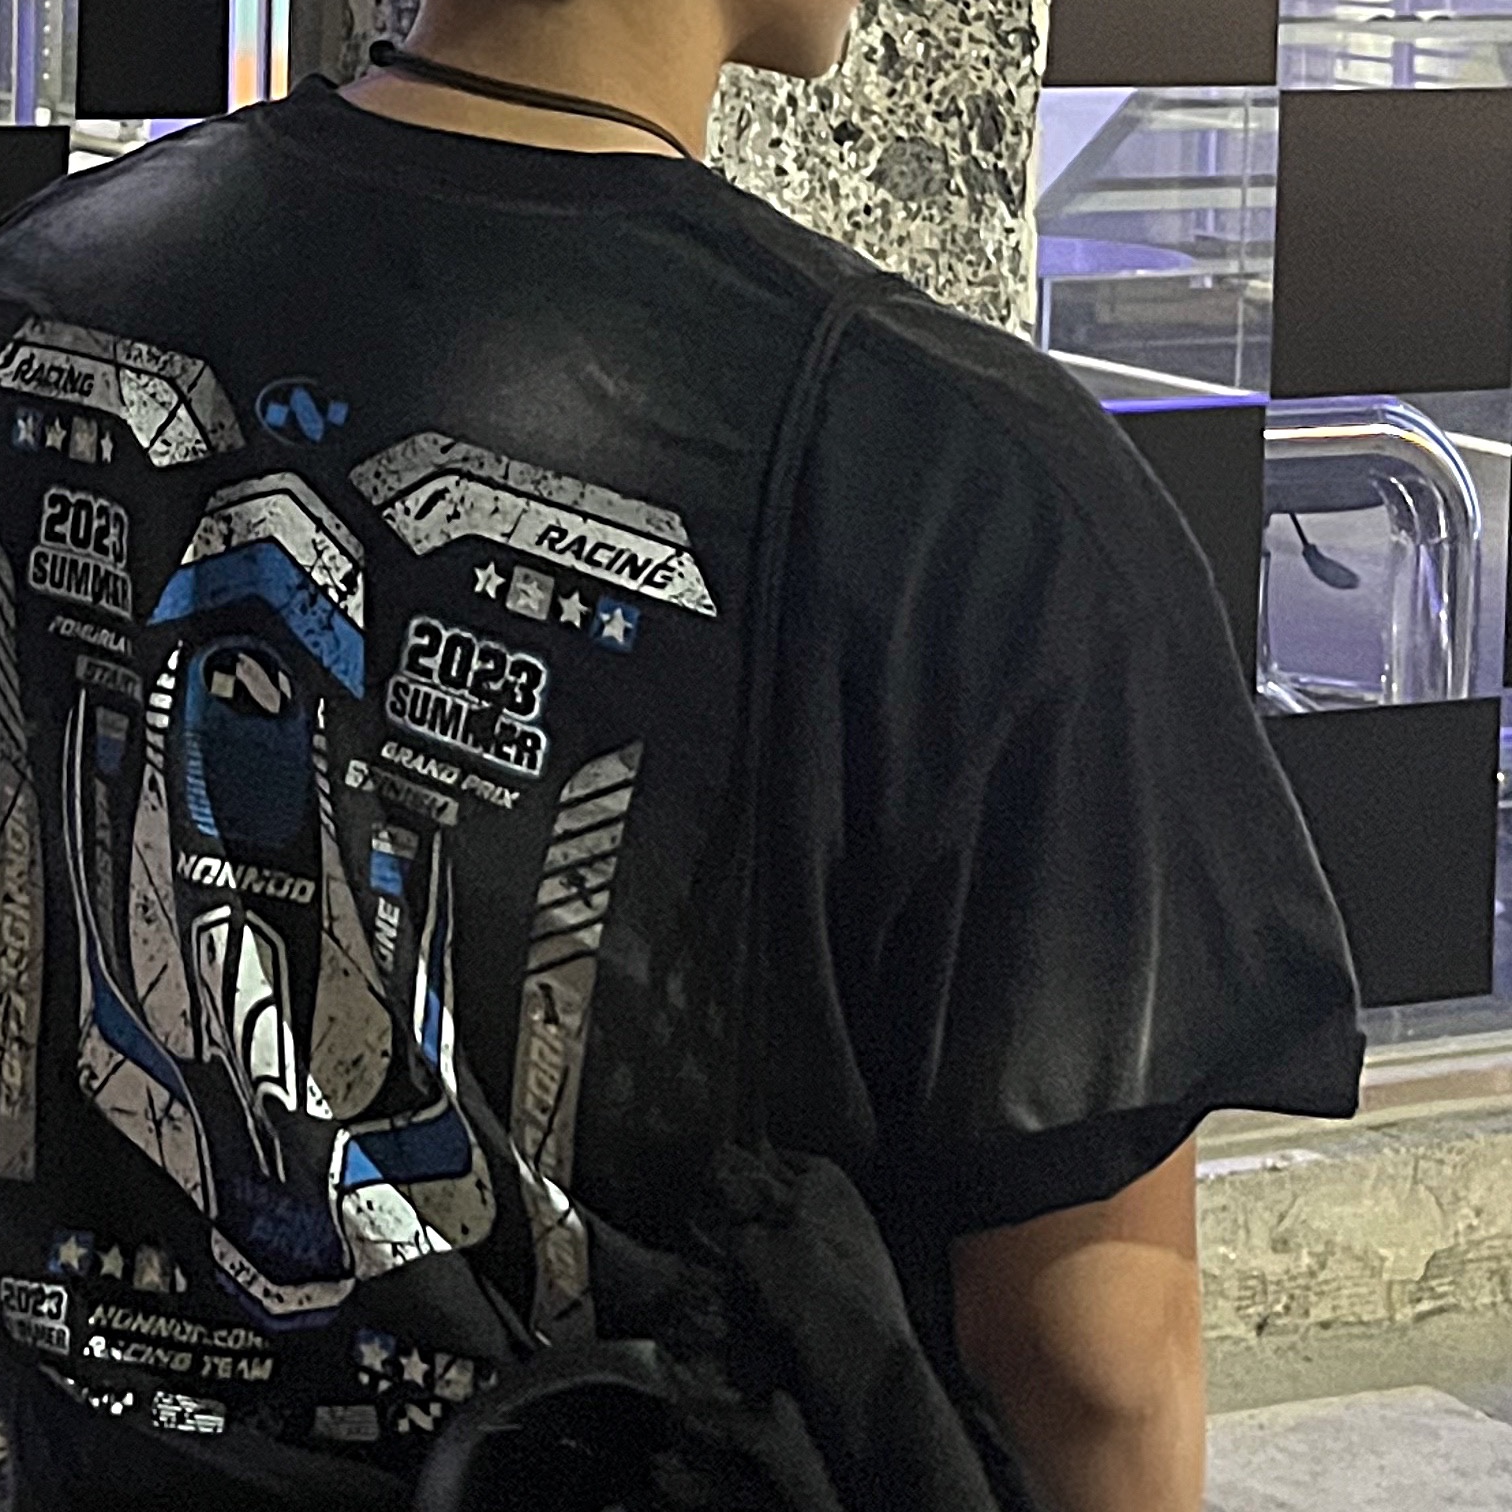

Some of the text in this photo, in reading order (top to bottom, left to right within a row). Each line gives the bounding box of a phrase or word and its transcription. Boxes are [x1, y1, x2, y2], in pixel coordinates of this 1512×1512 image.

[42, 489, 128, 568] 2023
[399, 616, 548, 721] 2023
[389, 675, 548, 776] SUMER
[381, 741, 462, 784] GRAND
[461, 774, 521, 809] PRIX
[0, 1277, 68, 1322] 2023
